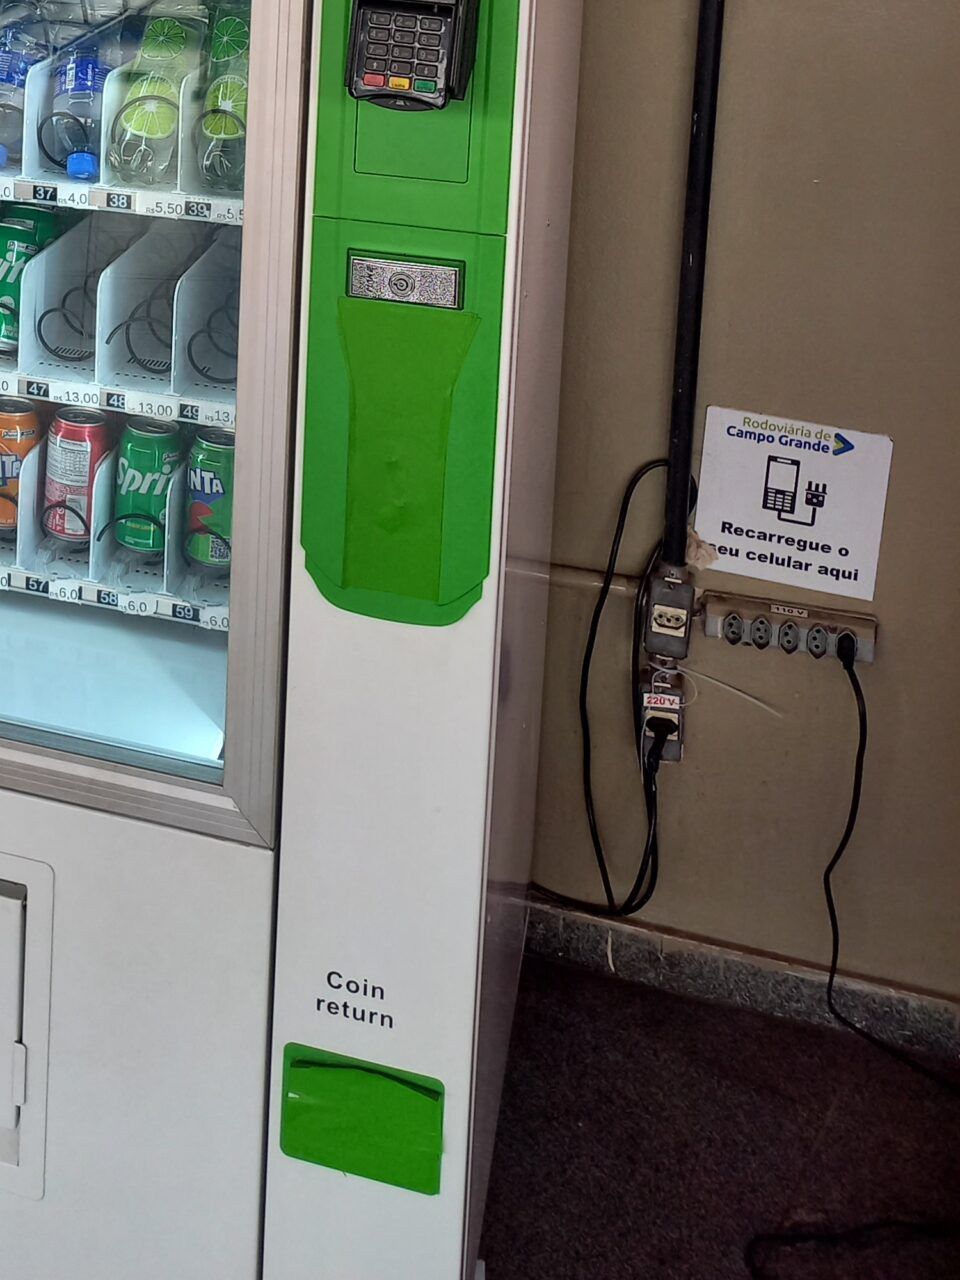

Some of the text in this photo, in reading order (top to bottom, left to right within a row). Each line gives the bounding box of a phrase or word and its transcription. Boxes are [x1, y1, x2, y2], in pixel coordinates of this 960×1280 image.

[35, 186, 53, 200] 37
[109, 194, 128, 208] 38
[188, 202, 206, 216] 39
[28, 383, 48, 396] 47
[108, 394, 126, 408] 48
[182, 405, 199, 419] 49
[742, 417, 831, 441] Rodoviária de
[726, 425, 830, 454] Campo Grande
[117, 456, 172, 496] Spri
[720, 521, 850, 557] Recarregue o
[745, 550, 812, 572] celular
[817, 564, 859, 581] aqui
[28, 578, 45, 591] 57
[100, 590, 118, 604] 58
[175, 606, 194, 619] 59
[646, 695, 666, 705] 220
[326, 971, 386, 1000] Coin
[315, 997, 394, 1029] return
